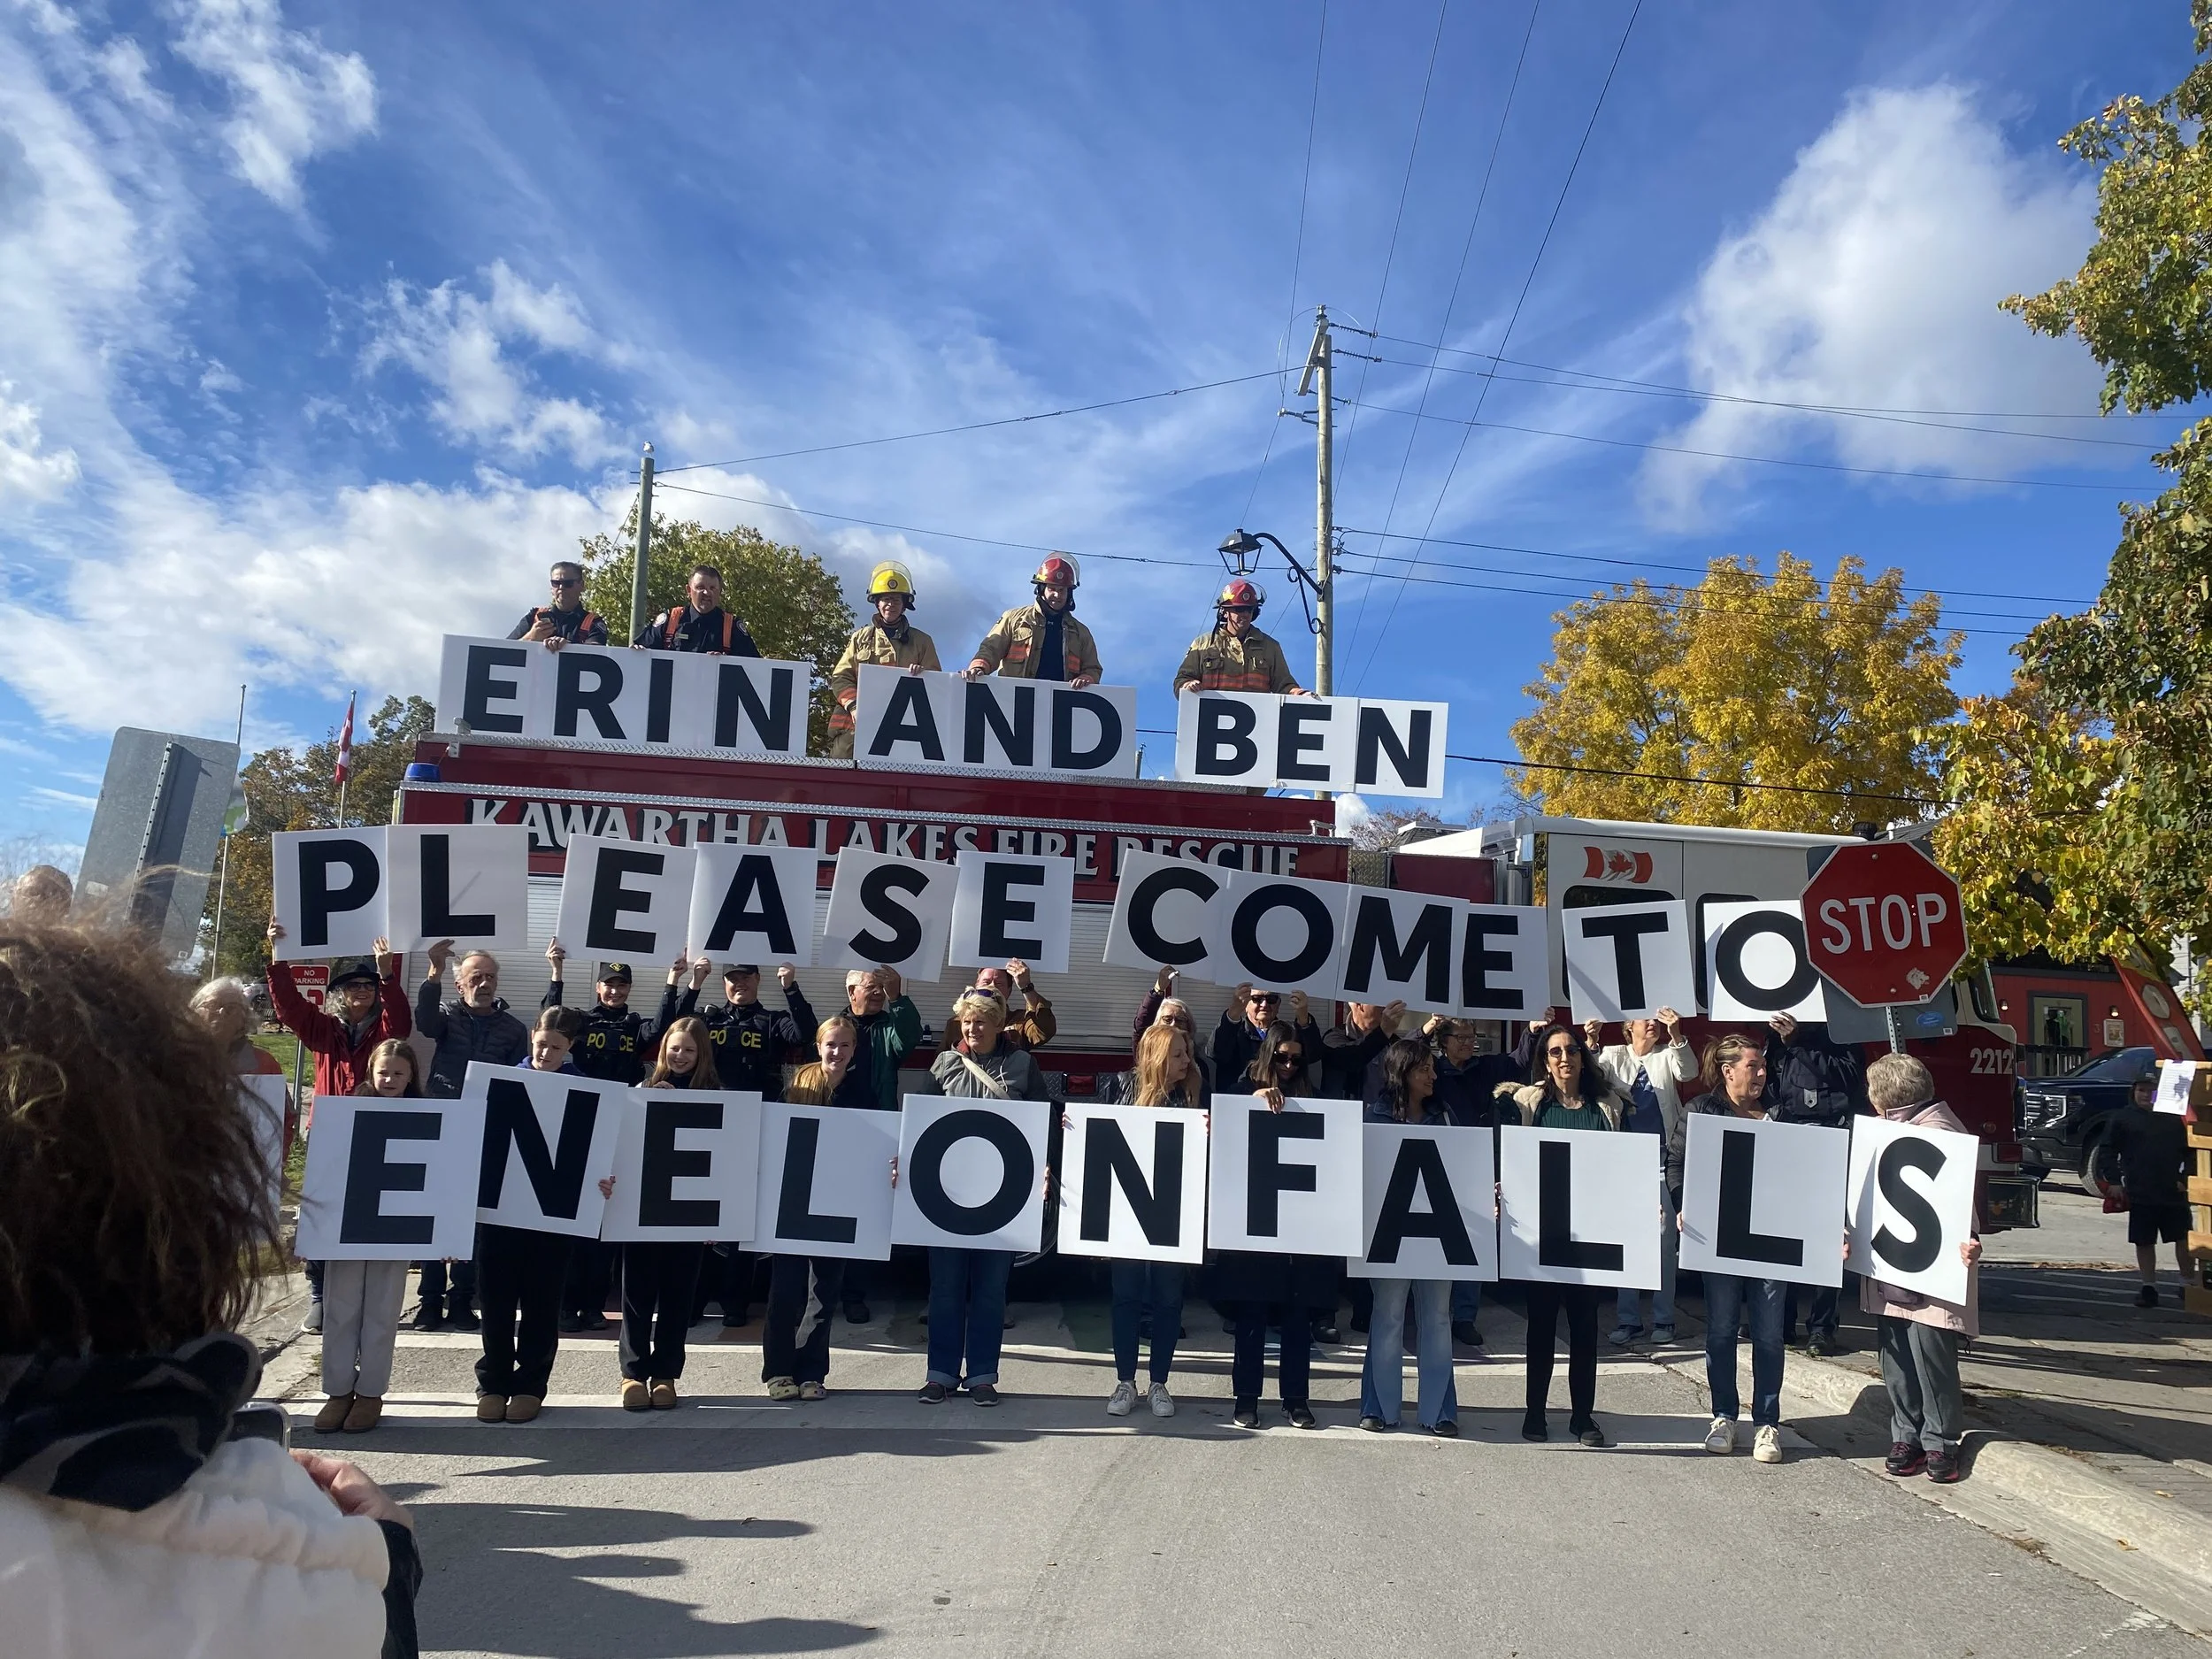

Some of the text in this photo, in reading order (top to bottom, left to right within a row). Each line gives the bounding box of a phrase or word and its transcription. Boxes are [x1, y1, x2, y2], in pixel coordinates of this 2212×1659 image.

[463, 645, 1432, 788] ERIN AND BEN
[471, 798, 791, 849] KAWARTHA
[814, 818, 979, 865] LAKES
[997, 829, 1097, 874] FIRE
[298, 833, 1820, 1011] PLEASE COME TO
[1820, 893, 1947, 954] STOP
[587, 1032, 634, 1052] POCE
[709, 1029, 762, 1048] POCE
[1970, 1047, 2015, 1074] 2212
[1246, 1110, 1947, 1272] FALLS
